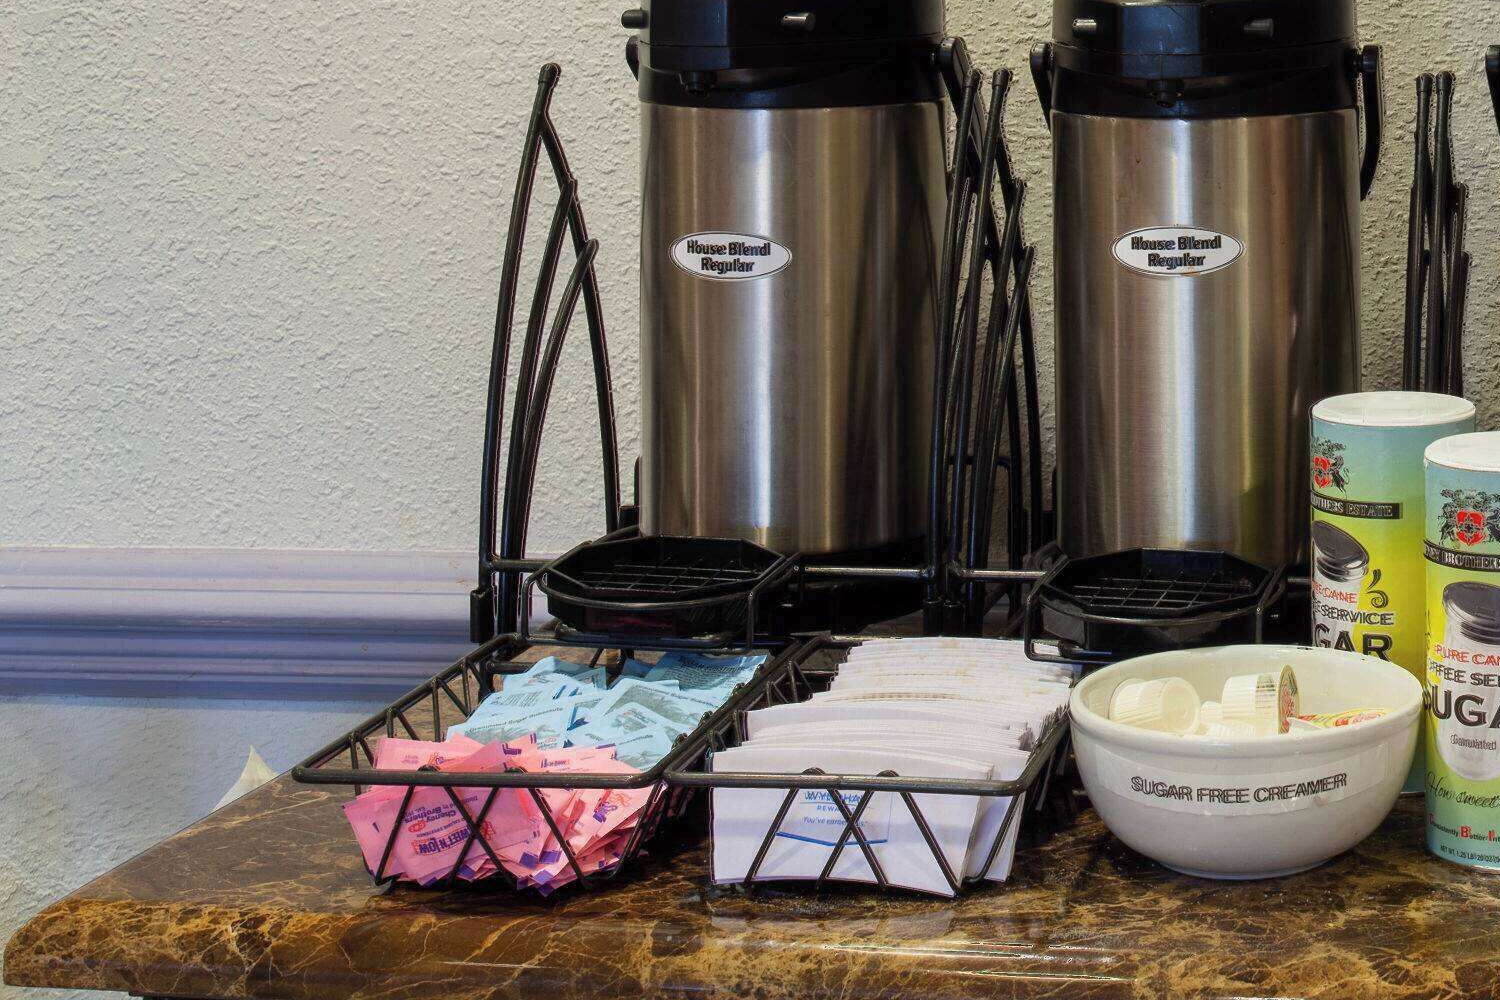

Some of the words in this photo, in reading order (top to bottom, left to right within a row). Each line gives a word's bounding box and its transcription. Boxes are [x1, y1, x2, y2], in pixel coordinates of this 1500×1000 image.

[686, 239, 727, 256] House
[728, 241, 771, 257] Blend
[1130, 235, 1176, 251] House
[1177, 234, 1223, 250] Blend
[701, 257, 755, 275] Regular
[1147, 252, 1206, 270] Regular
[1346, 502, 1394, 518] ESTATE
[1323, 587, 1358, 604] CANE
[1320, 604, 1395, 626] SERVICE
[1314, 622, 1394, 663] GAR
[1434, 644, 1470, 664] PURE
[1131, 775, 1193, 803] SUGAR
[1196, 787, 1251, 804] FREE
[1252, 772, 1348, 804] CREAMER
[1455, 790, 1500, 809] sweet
